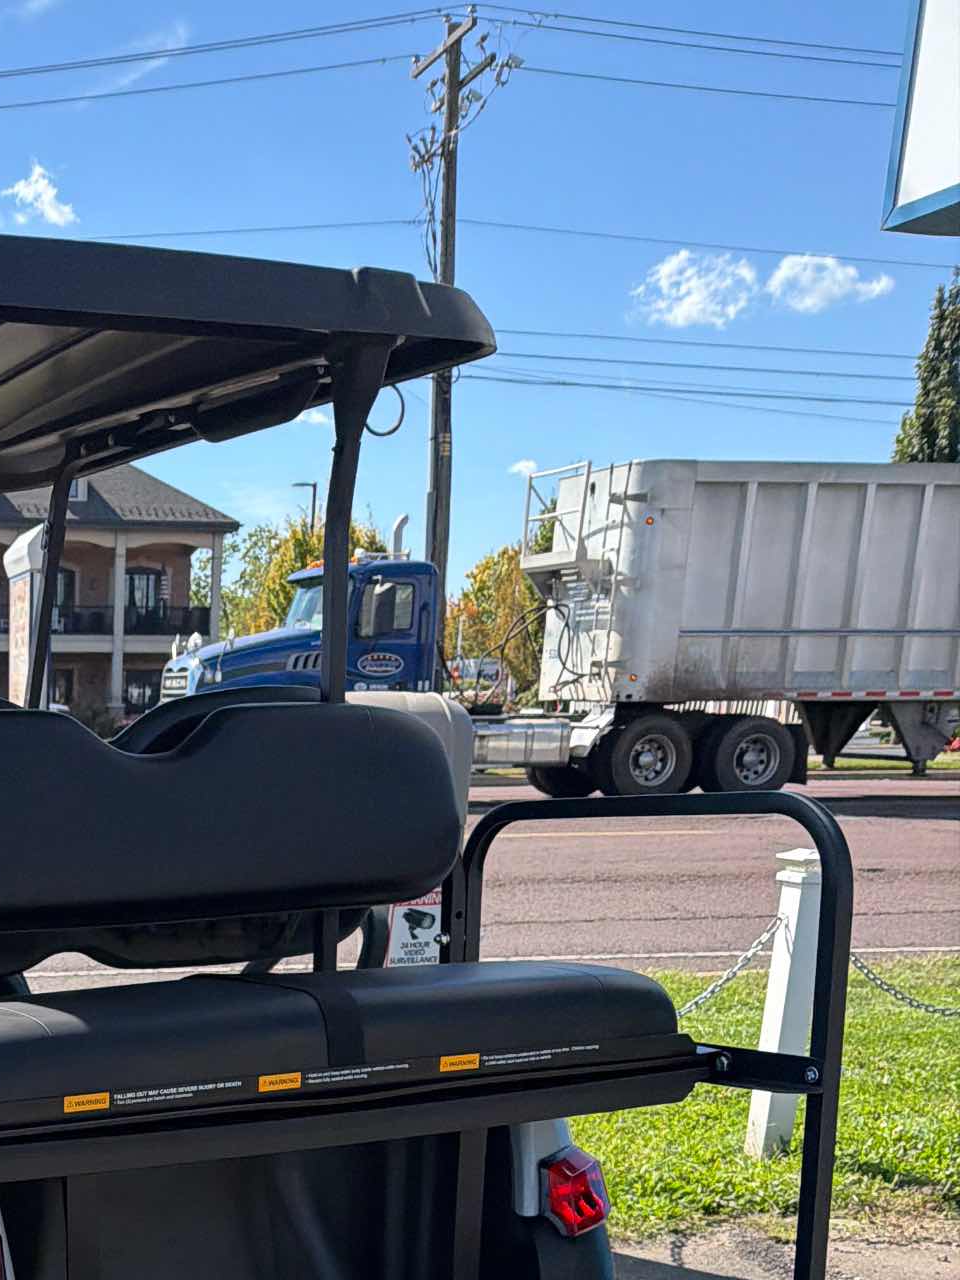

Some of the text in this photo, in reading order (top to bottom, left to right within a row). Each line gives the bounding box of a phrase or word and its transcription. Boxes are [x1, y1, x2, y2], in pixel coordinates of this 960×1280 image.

[410, 941, 431, 949] HOUR
[390, 956, 438, 965] SURVEILLANCE
[449, 1058, 477, 1067] WARNING
[268, 1077, 299, 1087] WARNING
[74, 1097, 107, 1108] WARNING
